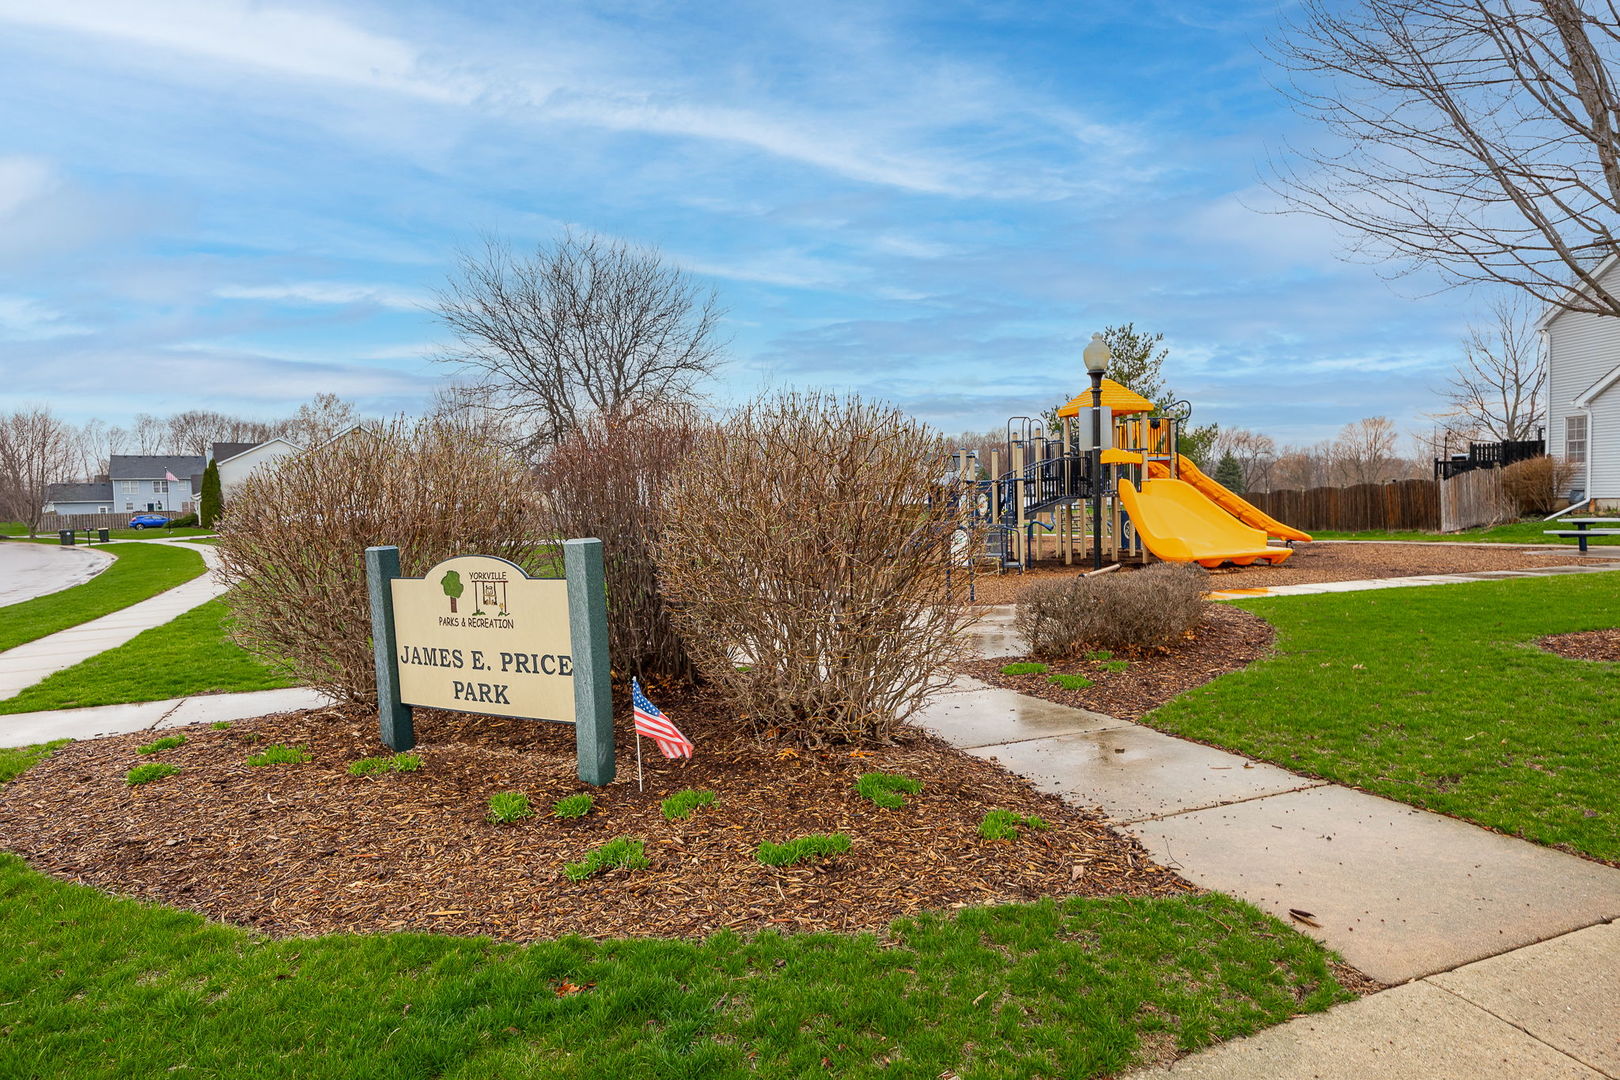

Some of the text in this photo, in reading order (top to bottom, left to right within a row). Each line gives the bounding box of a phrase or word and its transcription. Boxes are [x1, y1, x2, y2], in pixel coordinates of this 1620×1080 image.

[469, 571, 507, 580] YORKVILLE
[439, 616, 514, 629] PARKS & RECREATION
[400, 645, 573, 676] JAMES E. PRICE
[453, 680, 511, 704] PARK
